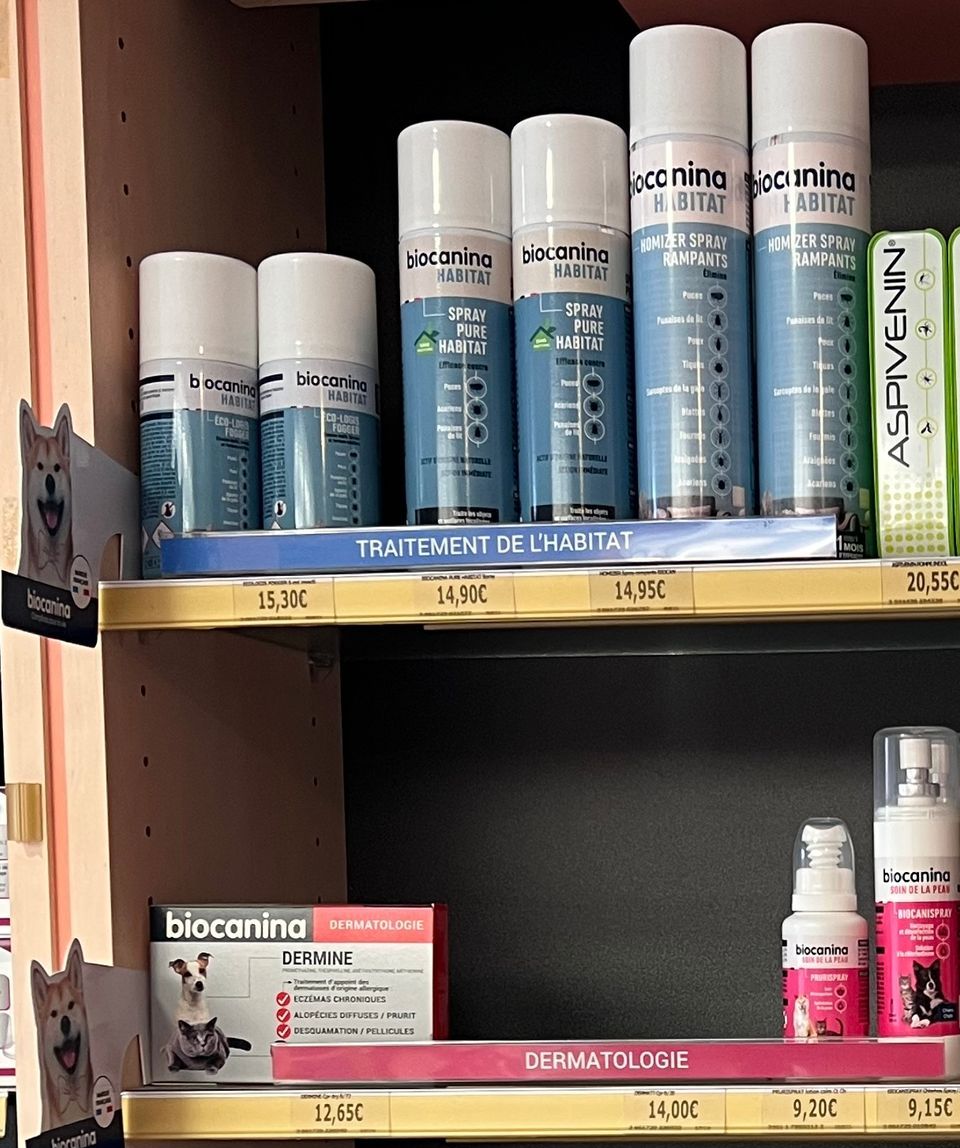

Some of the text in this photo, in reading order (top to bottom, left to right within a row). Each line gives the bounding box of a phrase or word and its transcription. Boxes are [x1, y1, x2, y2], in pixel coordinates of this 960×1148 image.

[630, 160, 726, 197] iocanina
[641, 234, 727, 253] HOMIZER SPRAY
[406, 247, 492, 269] biocanina
[663, 252, 727, 268] RAMPANTS
[437, 269, 491, 285] HABITAT
[448, 307, 487, 323] SPRAY
[457, 324, 487, 339] PURE
[883, 248, 910, 468] ASPIVENIN
[297, 371, 367, 392] biocanina
[333, 424, 360, 435] FOGGER
[356, 535, 490, 558] TRAITEMENT
[497, 535, 525, 554] DE
[615, 579, 666, 604] 14,95€
[907, 570, 960, 595] 20,55€
[27, 588, 70, 619] biocanina
[258, 590, 308, 612] 15,30€
[437, 584, 487, 608] 14,90€
[883, 868, 950, 883] biocanina
[898, 908, 952, 919] BIOCANISPRAY
[166, 911, 424, 940] biocanina DERMATOLOGIE
[282, 951, 353, 966] DERMINE
[796, 944, 848, 956] biocanina
[334, 995, 386, 1004] CHRONIQUES
[294, 1010, 337, 1019] ALOPÉCIES
[294, 1027, 358, 1036] DESQUAMATION
[524, 1051, 689, 1070] DERMATOLOGIE
[314, 1102, 364, 1126] 12,65€
[648, 1099, 699, 1122] 14,00€
[793, 1097, 837, 1119] 9,20€
[908, 1097, 953, 1119] 9,15€
